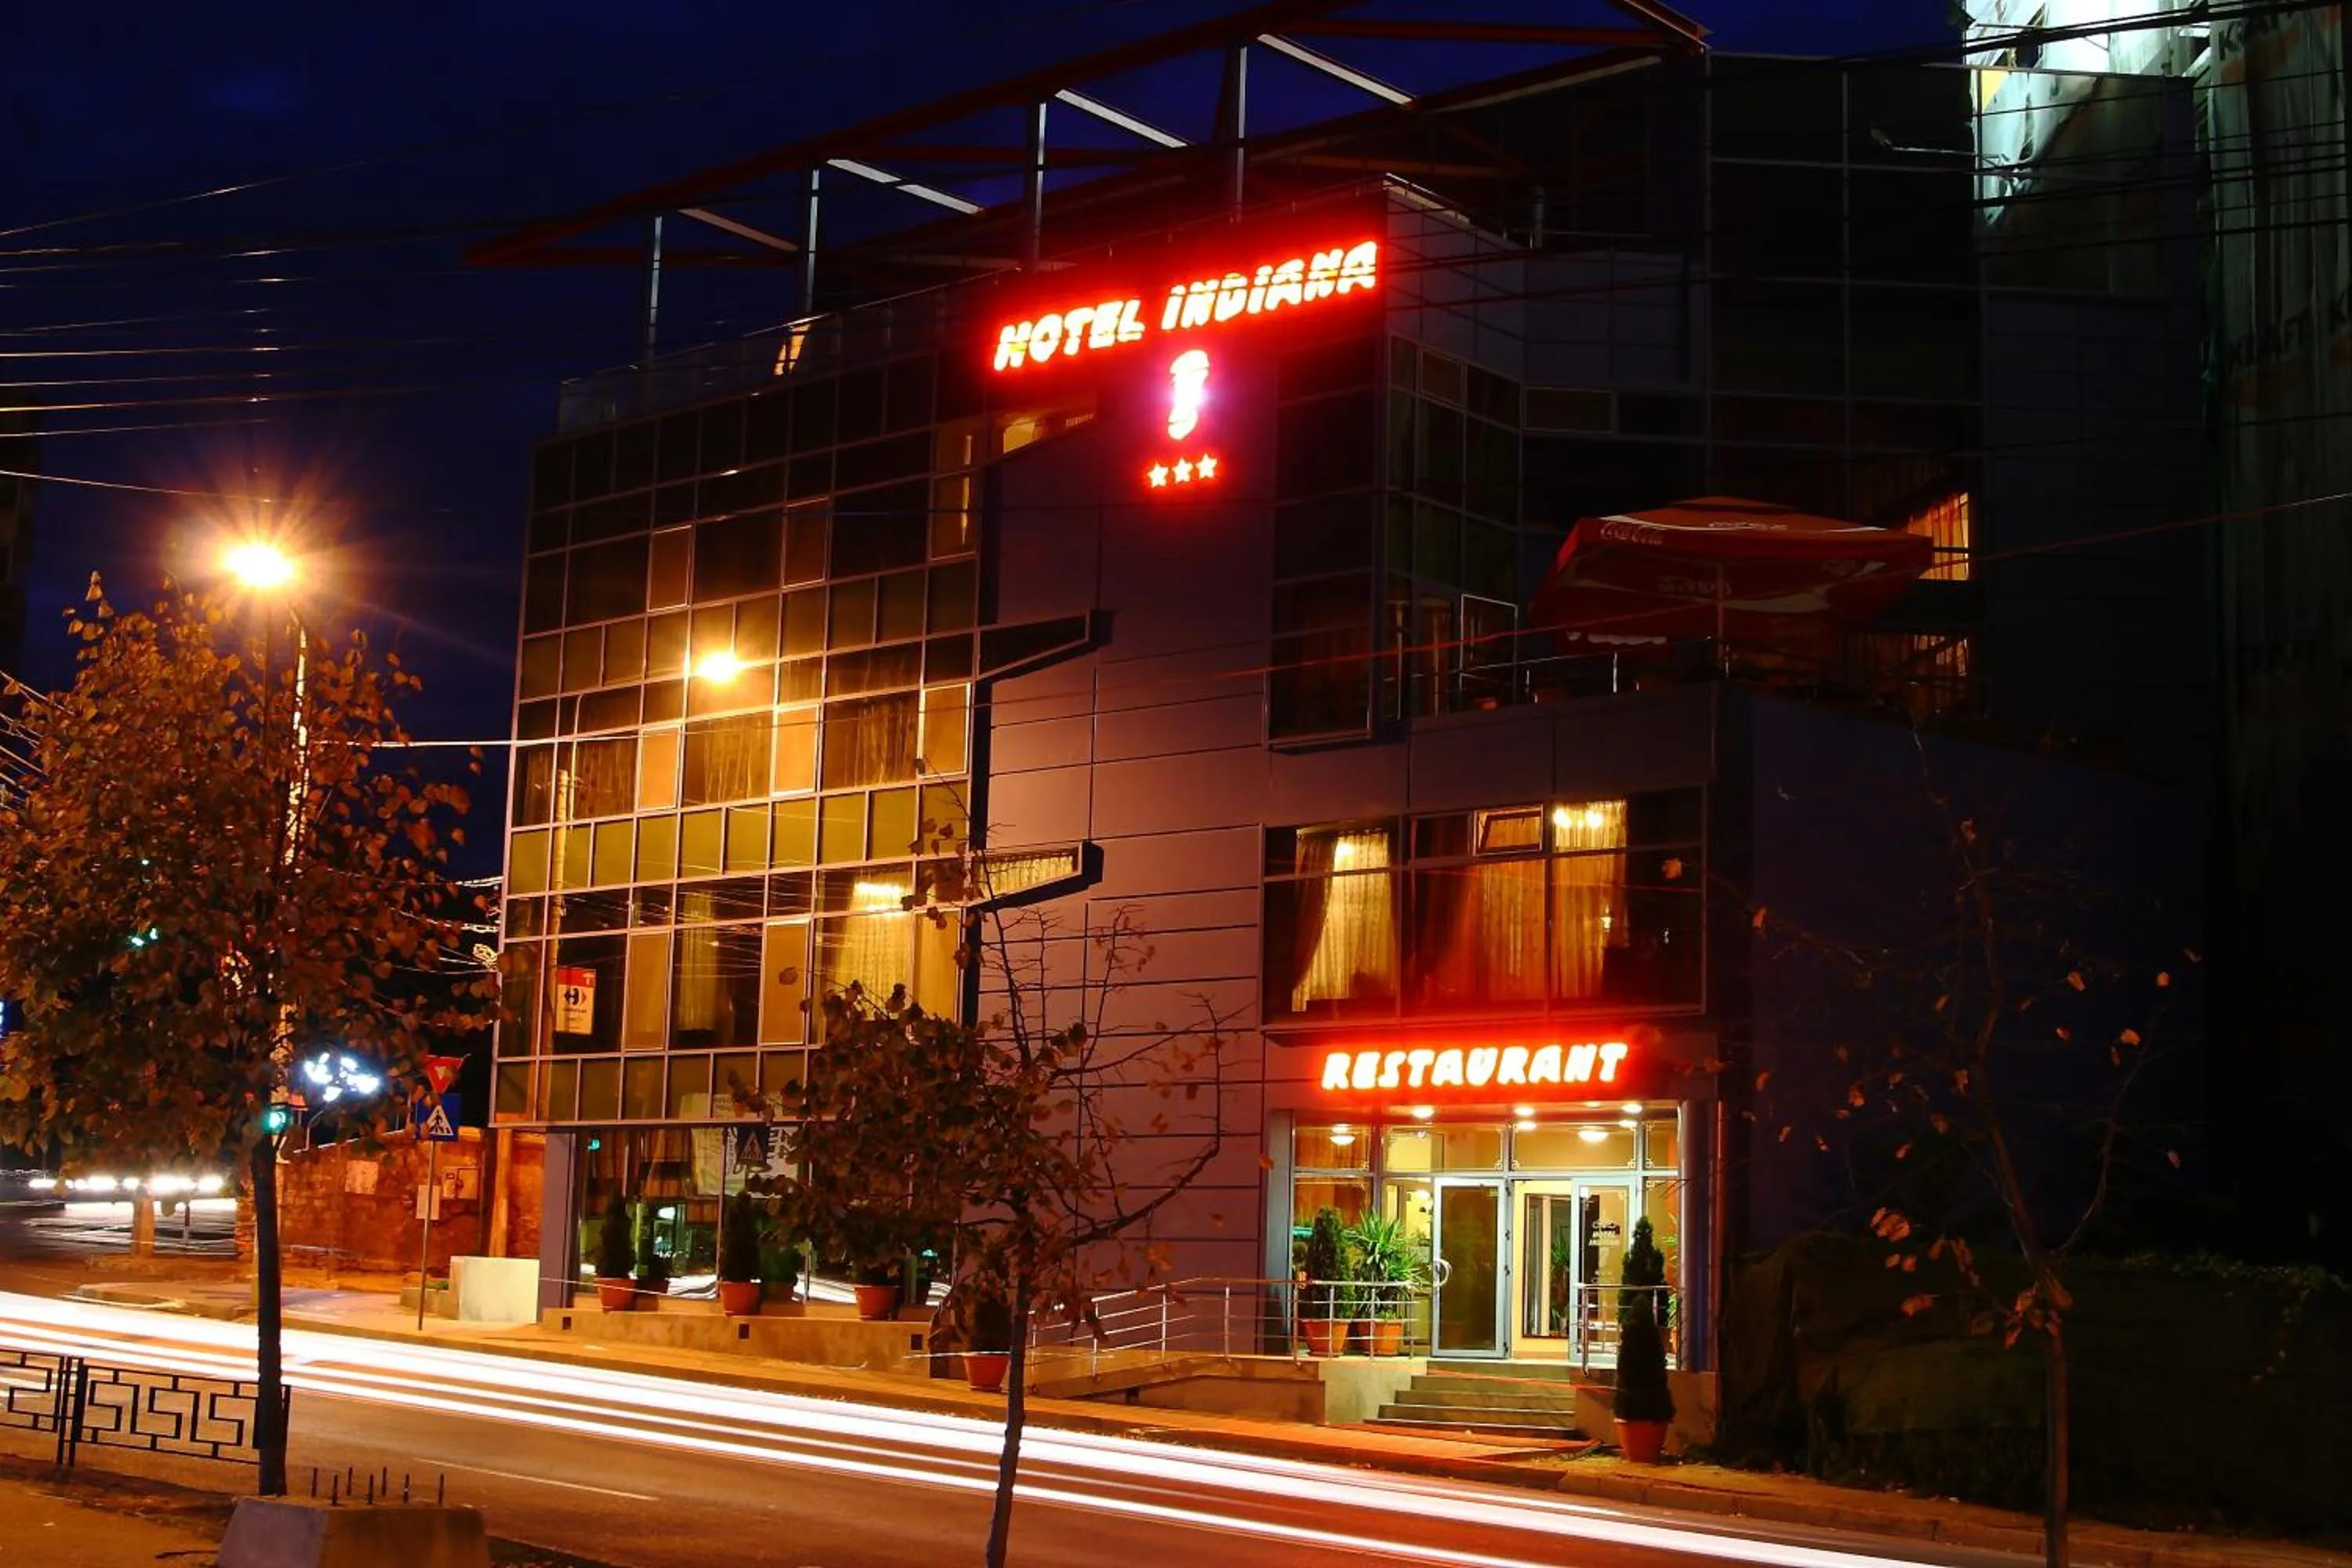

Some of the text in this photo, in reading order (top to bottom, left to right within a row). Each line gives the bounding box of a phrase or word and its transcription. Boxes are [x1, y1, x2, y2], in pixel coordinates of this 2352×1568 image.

[993, 241, 1378, 372] HOTEL INDIANA
[1321, 1042, 1628, 1091] RESTAURANT
